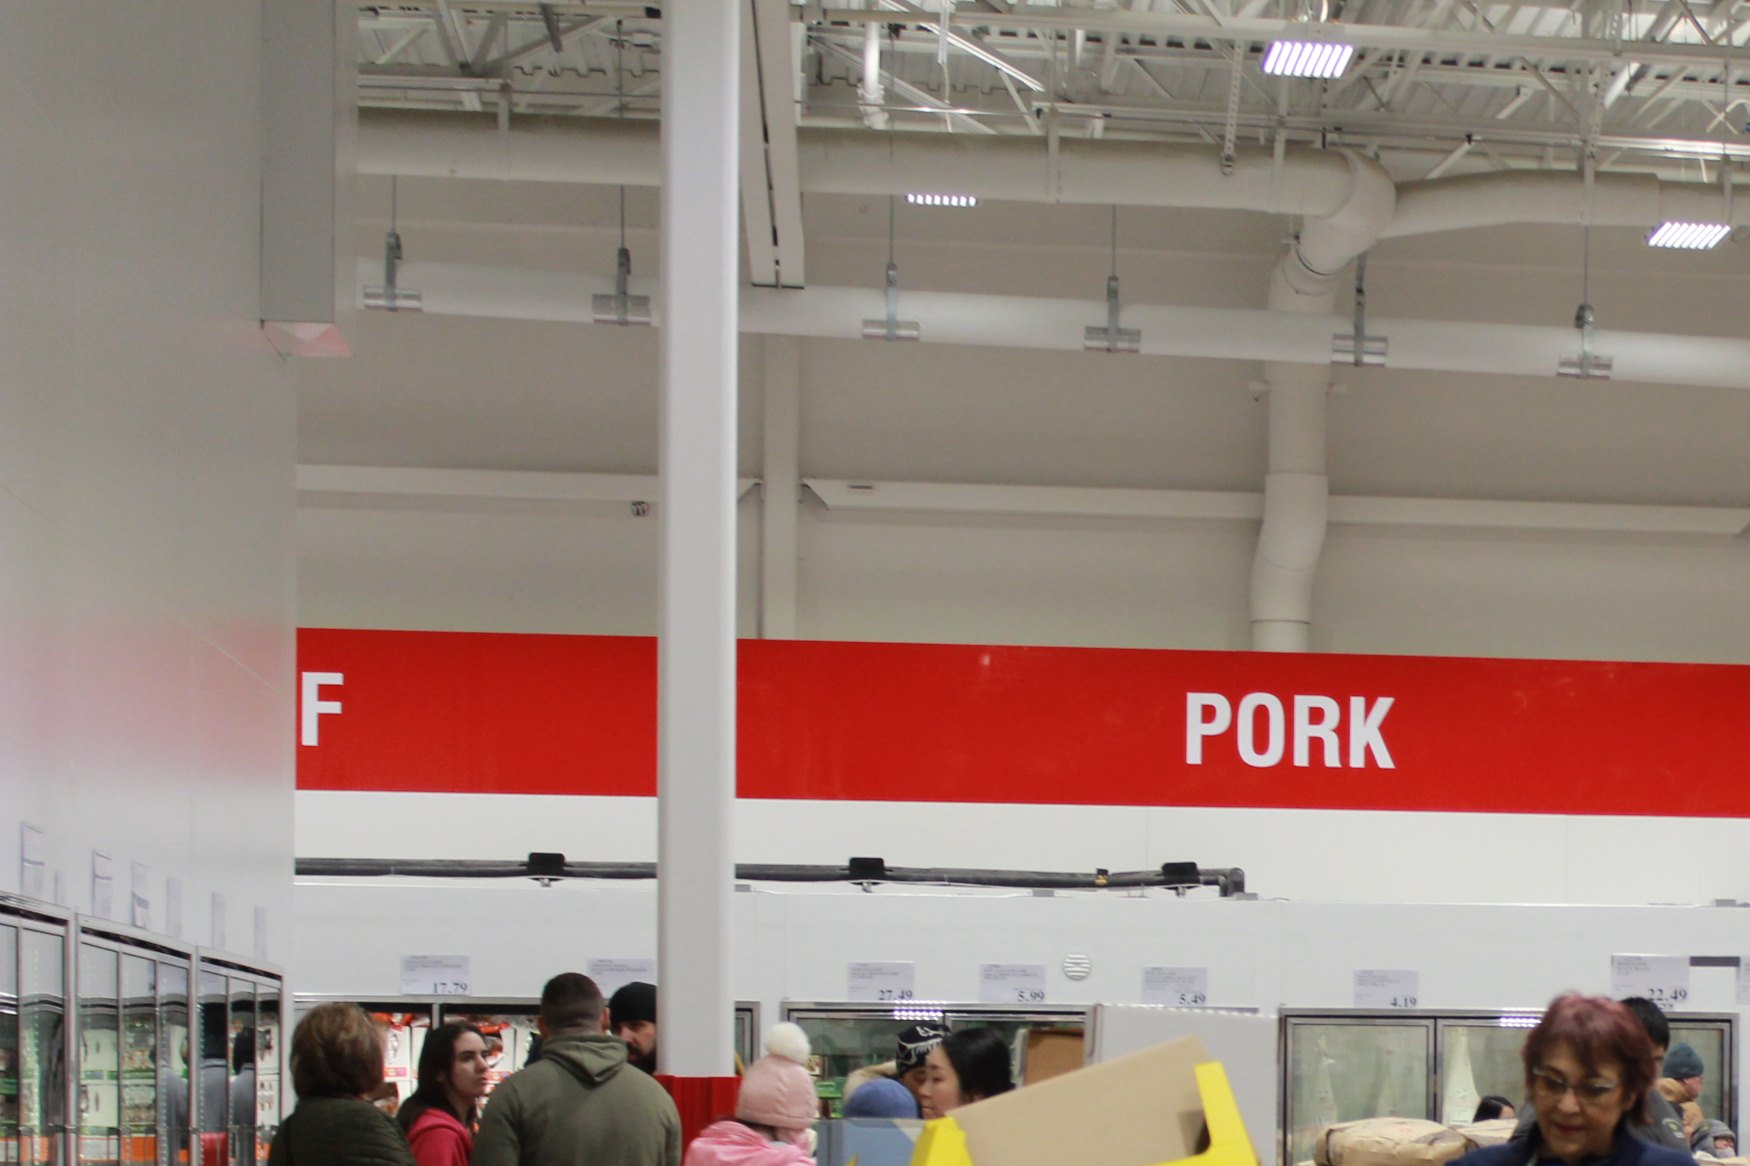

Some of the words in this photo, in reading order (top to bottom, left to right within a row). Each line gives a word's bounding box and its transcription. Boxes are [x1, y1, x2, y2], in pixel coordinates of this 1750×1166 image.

[1185, 691, 1397, 771] PORK
[432, 981, 469, 995] 17.79
[878, 988, 914, 1002] 27.49
[1646, 986, 1689, 1003] 22.49
[1016, 989, 1046, 1003] 5.99
[1177, 992, 1207, 1005] 5.49
